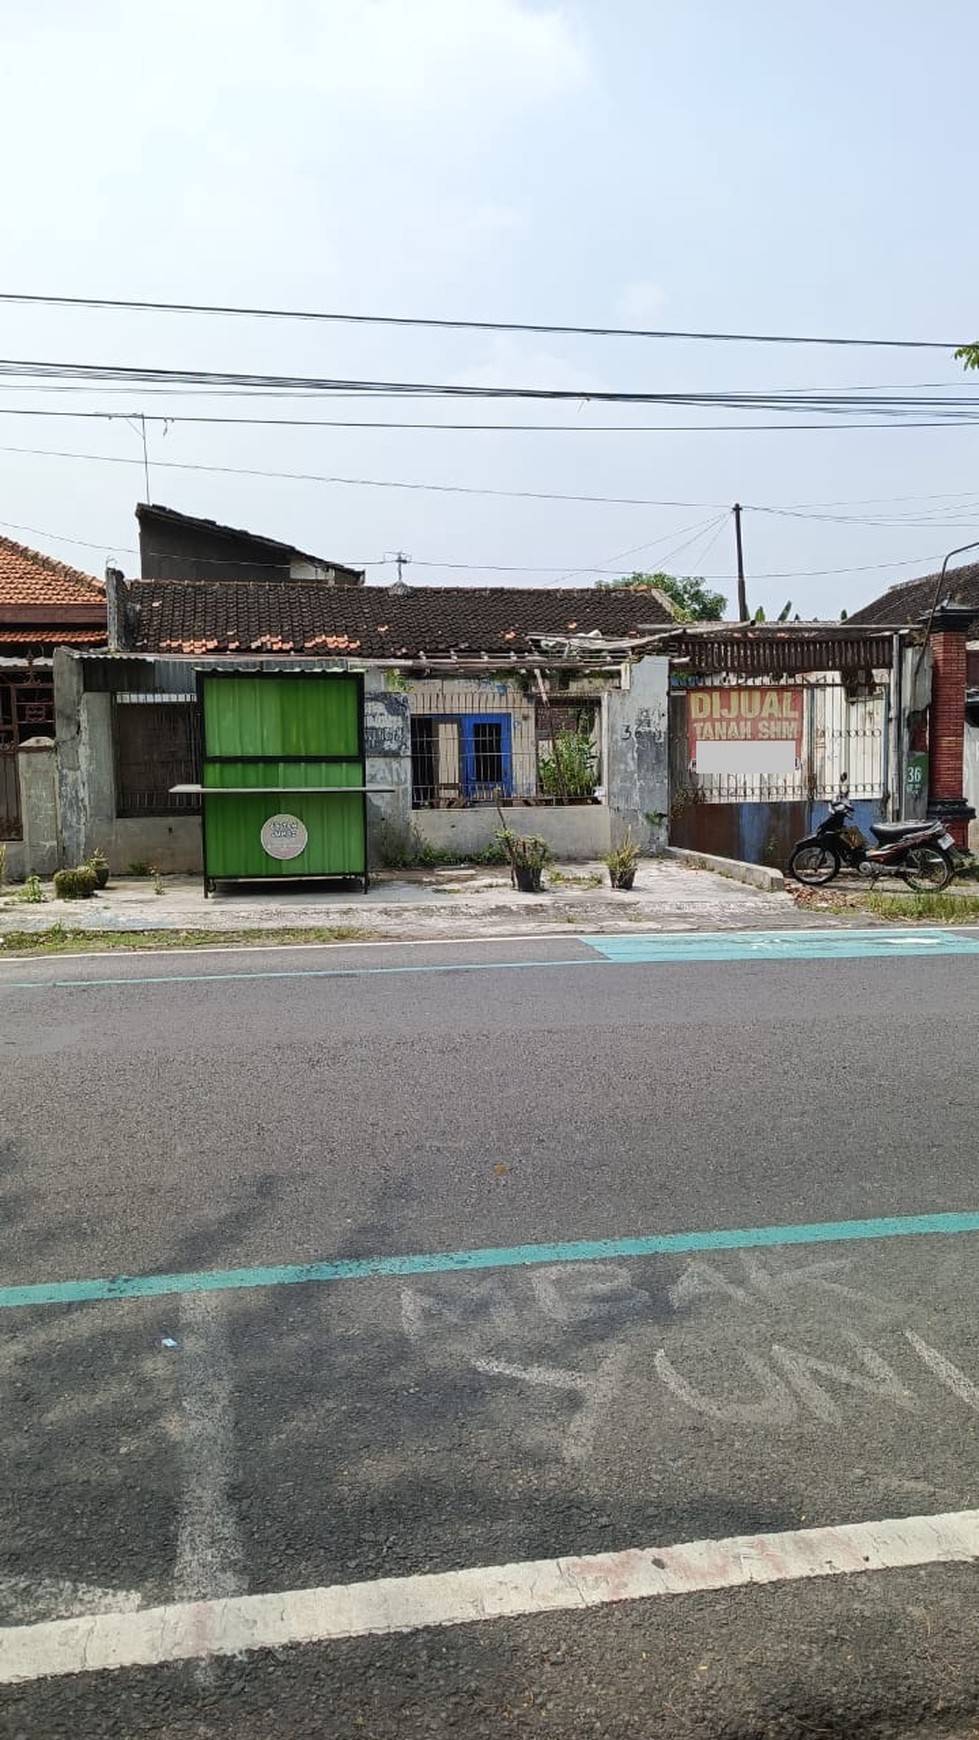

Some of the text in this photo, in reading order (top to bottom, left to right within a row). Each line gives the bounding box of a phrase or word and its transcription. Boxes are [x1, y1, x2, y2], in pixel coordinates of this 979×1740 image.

[690, 690, 799, 719] DIJUAL
[694, 720, 798, 740] TANAH SHM
[907, 766, 922, 782] 36
